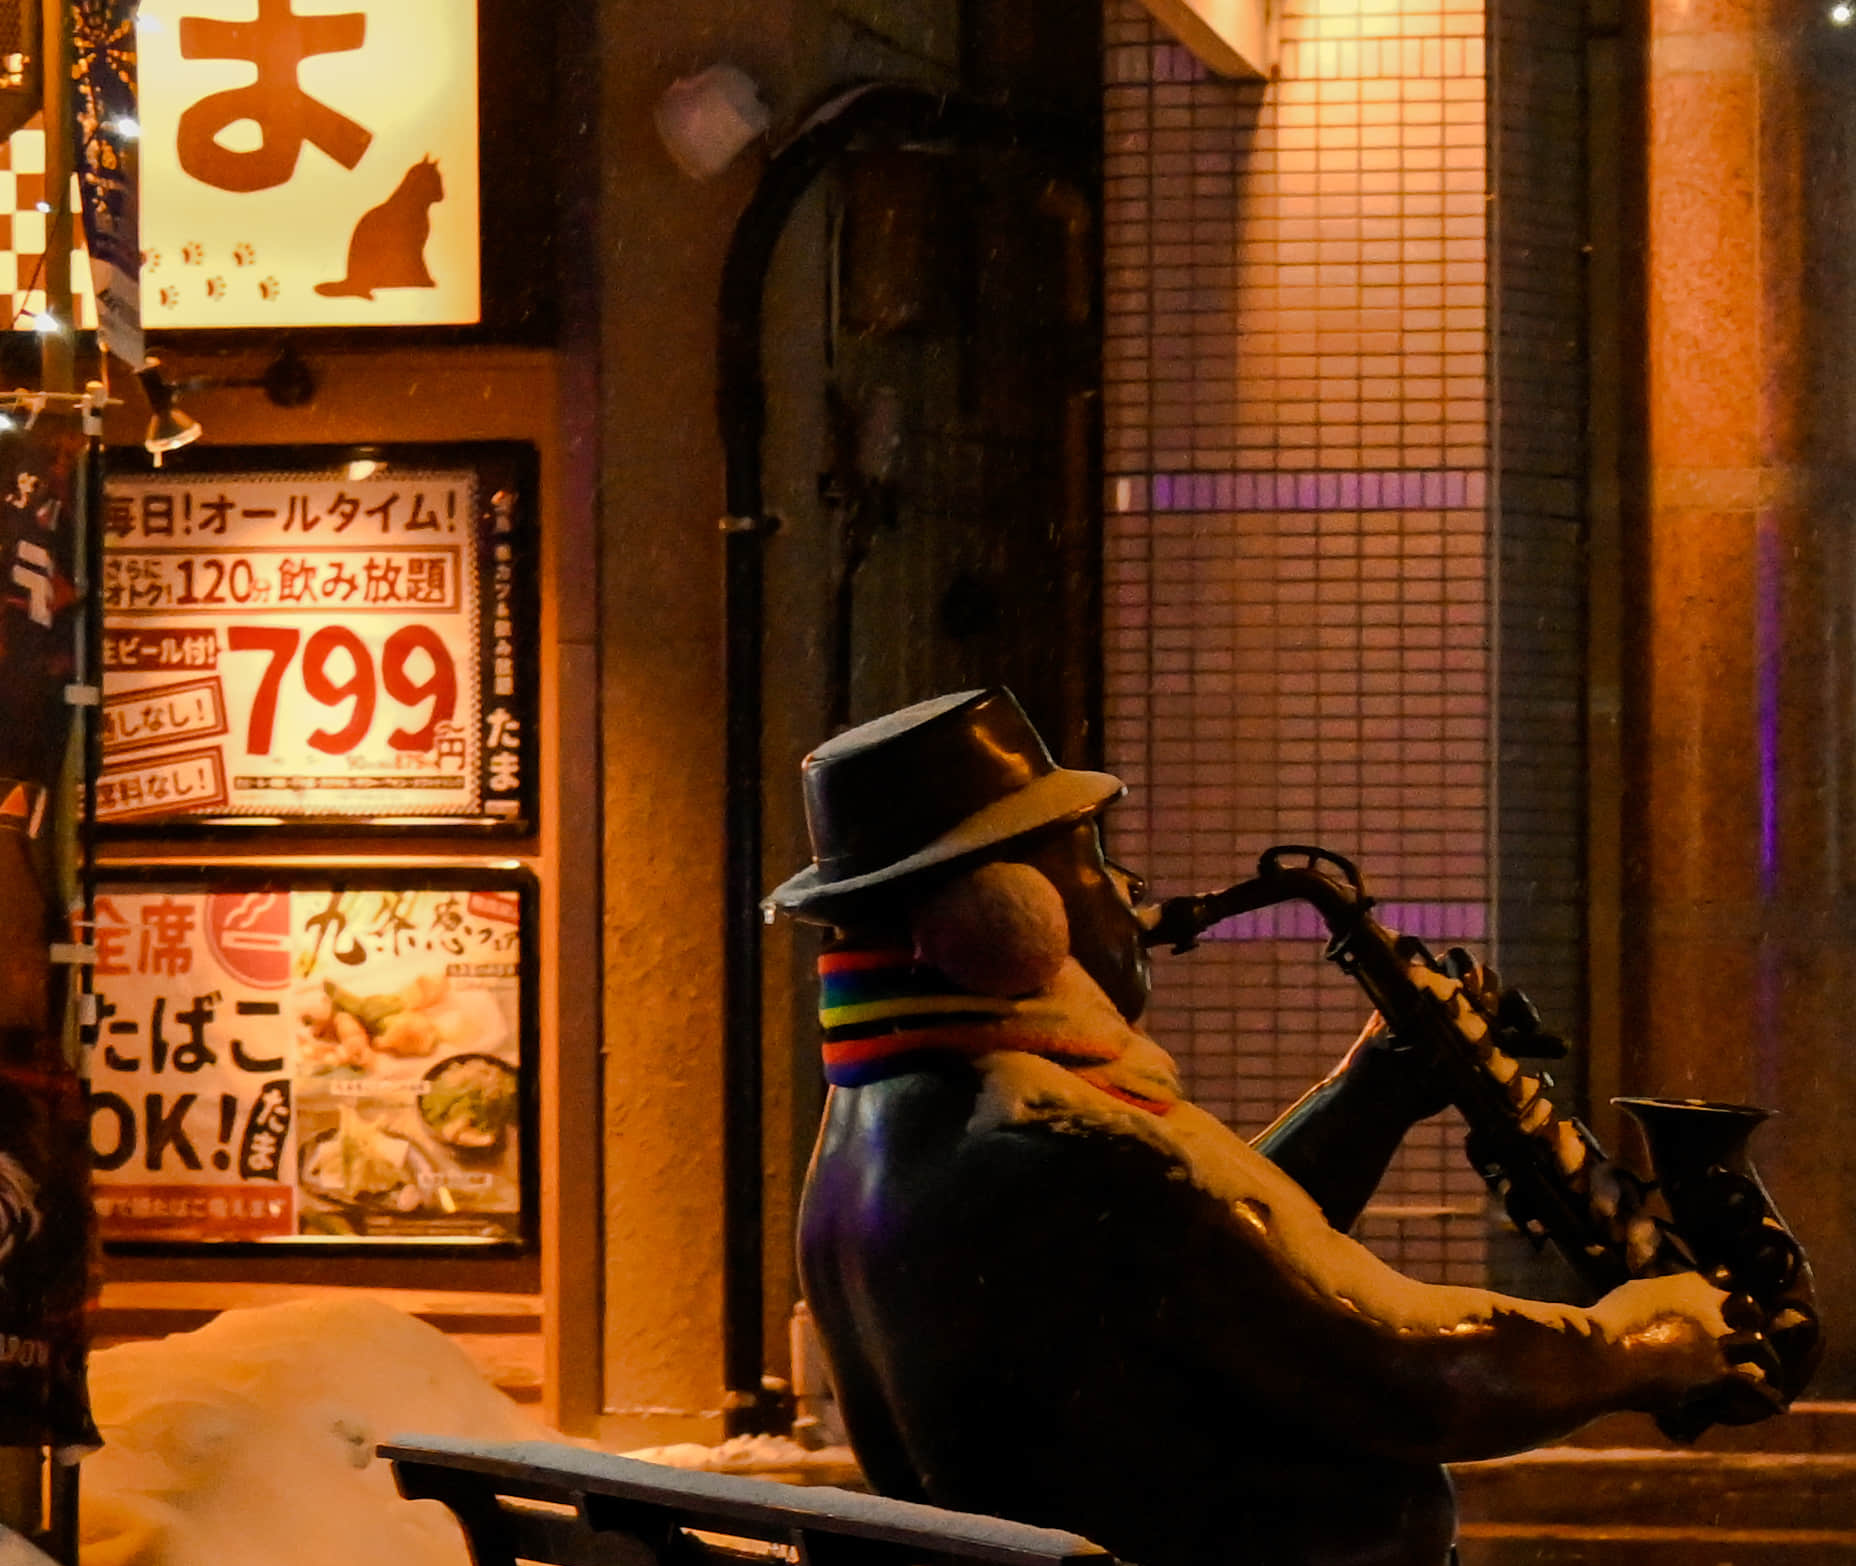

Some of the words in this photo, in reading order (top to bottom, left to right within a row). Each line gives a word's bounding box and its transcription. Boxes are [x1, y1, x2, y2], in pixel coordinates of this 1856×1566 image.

[176, 0, 374, 193] ま
[227, 624, 457, 756] 799
[486, 707, 520, 792] たま
[82, 897, 197, 978] 全席
[89, 1090, 238, 1172] OK!
[247, 1087, 290, 1171] たま
